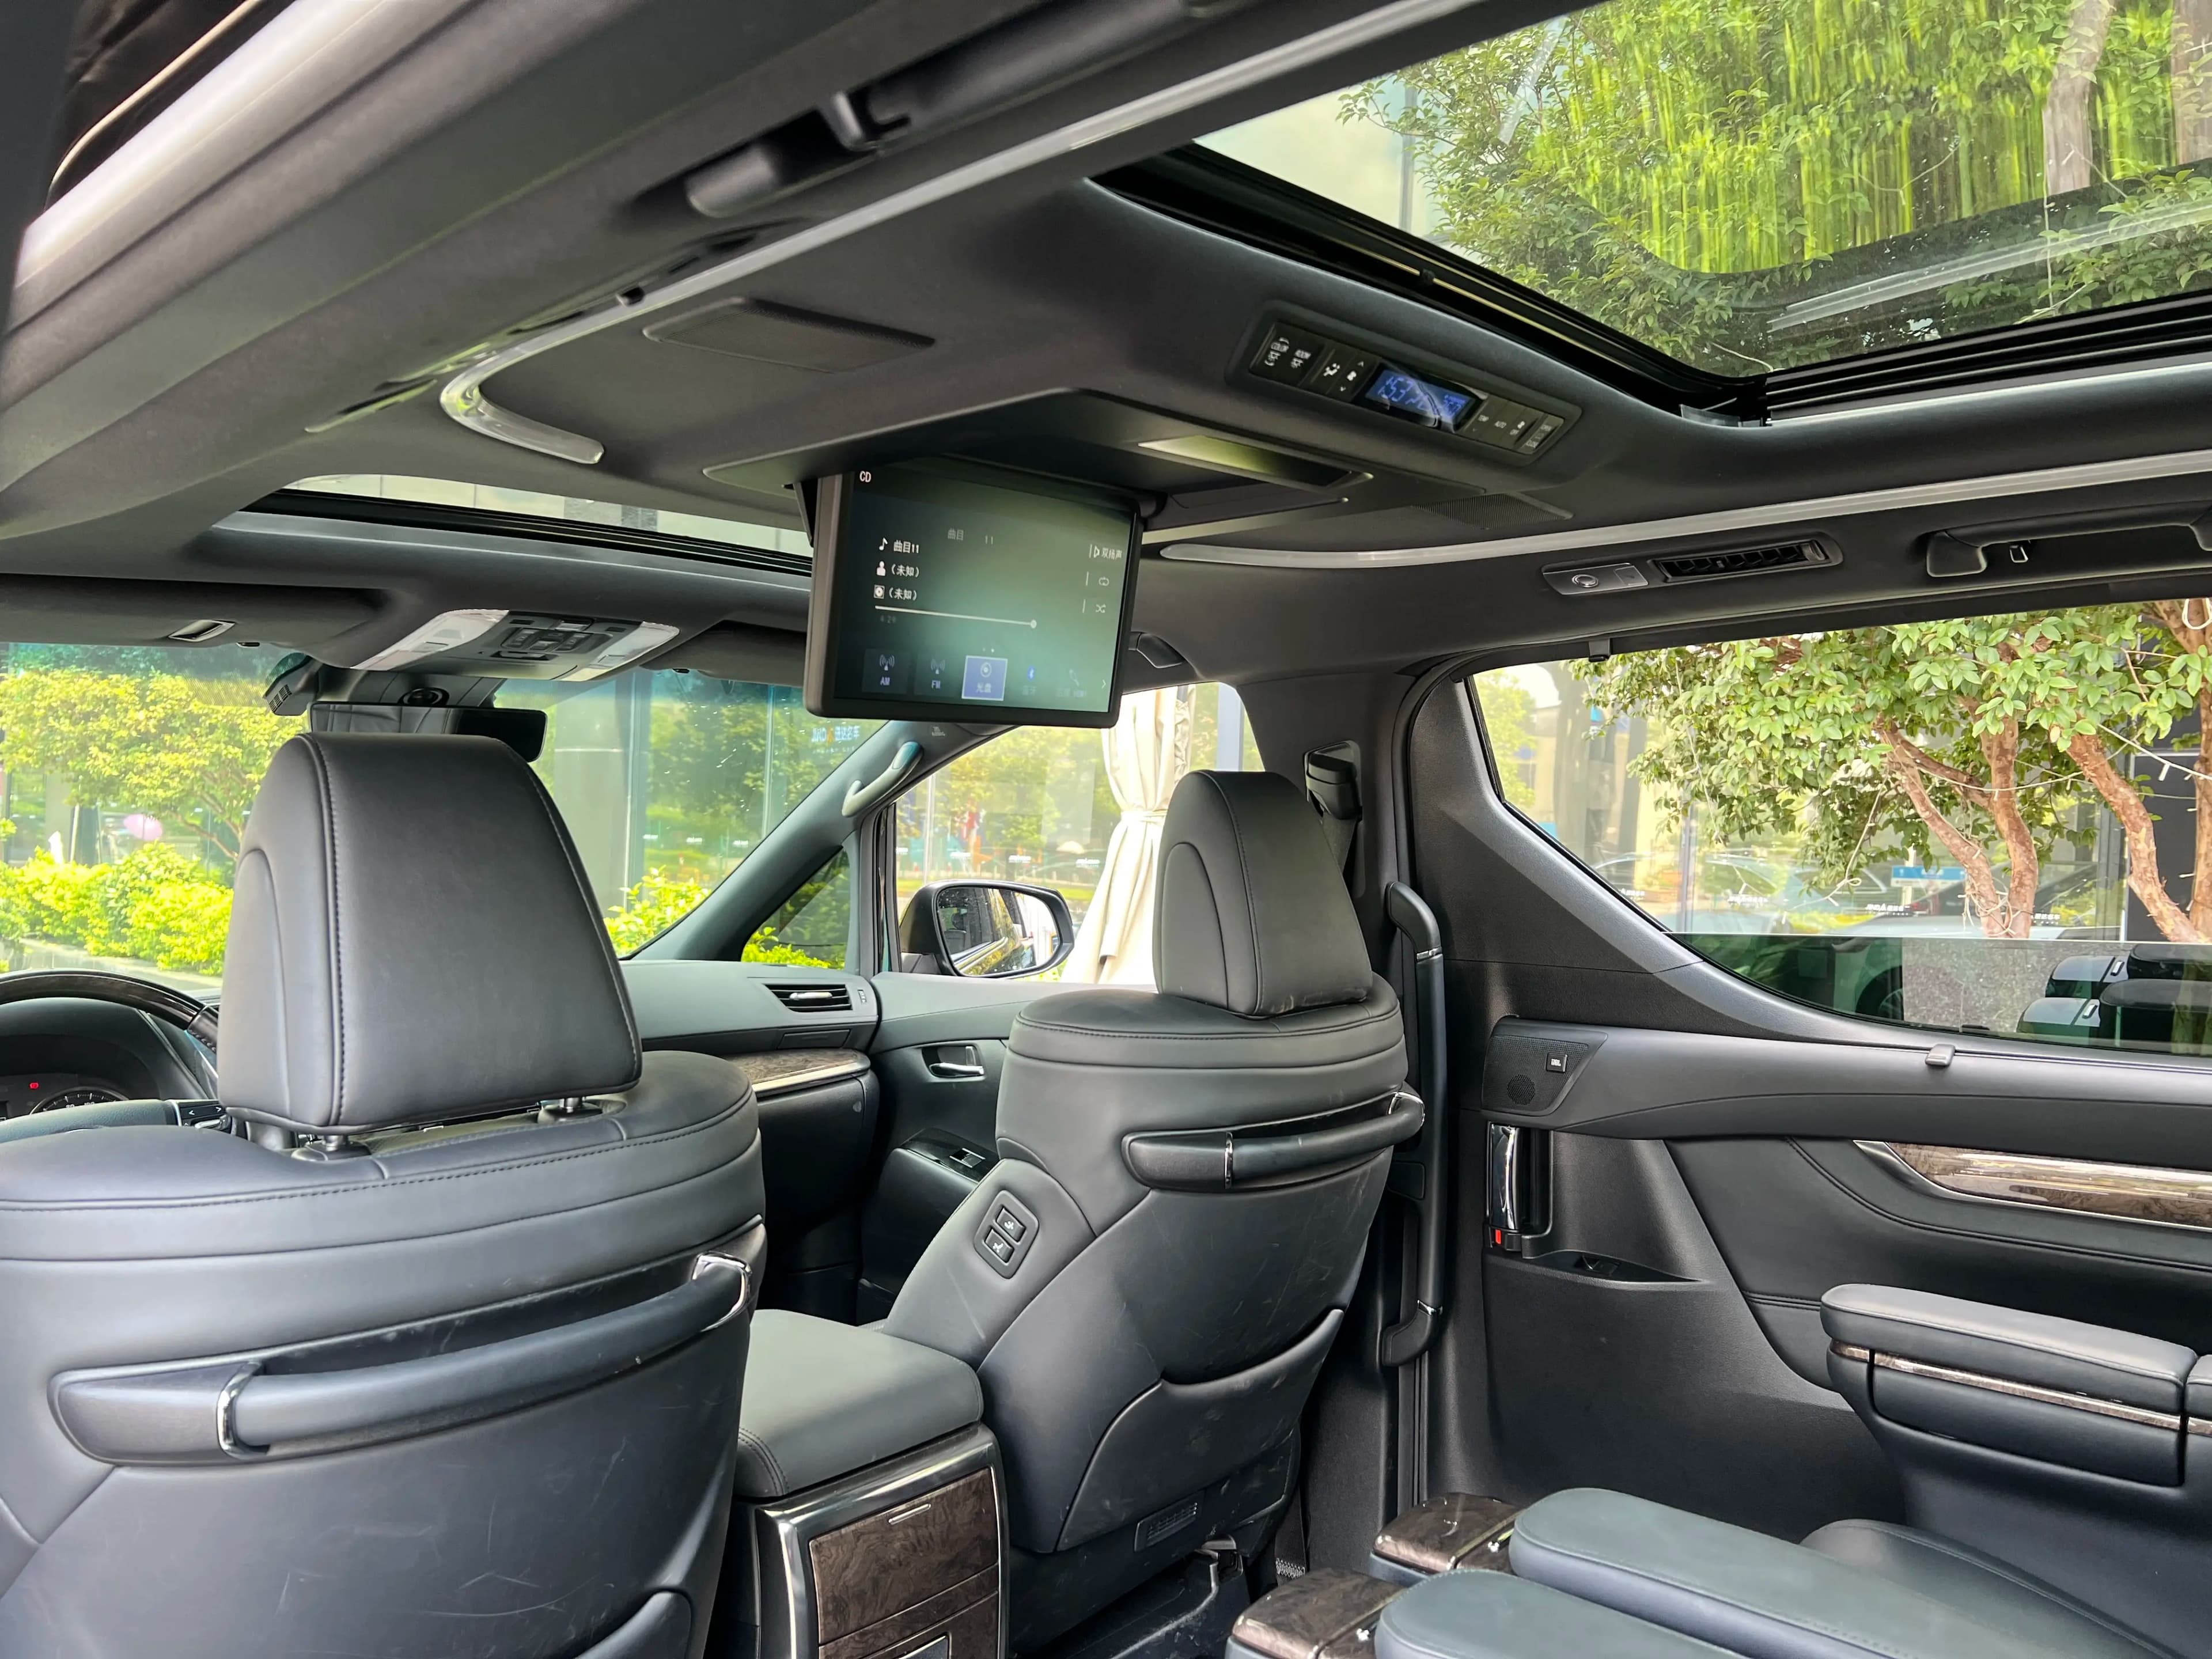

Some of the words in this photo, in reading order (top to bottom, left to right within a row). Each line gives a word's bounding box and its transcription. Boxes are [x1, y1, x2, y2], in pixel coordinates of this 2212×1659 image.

[859, 471, 872, 483] CD
[947, 528, 964, 541] 曲目
[893, 539, 920, 554] 曲目11
